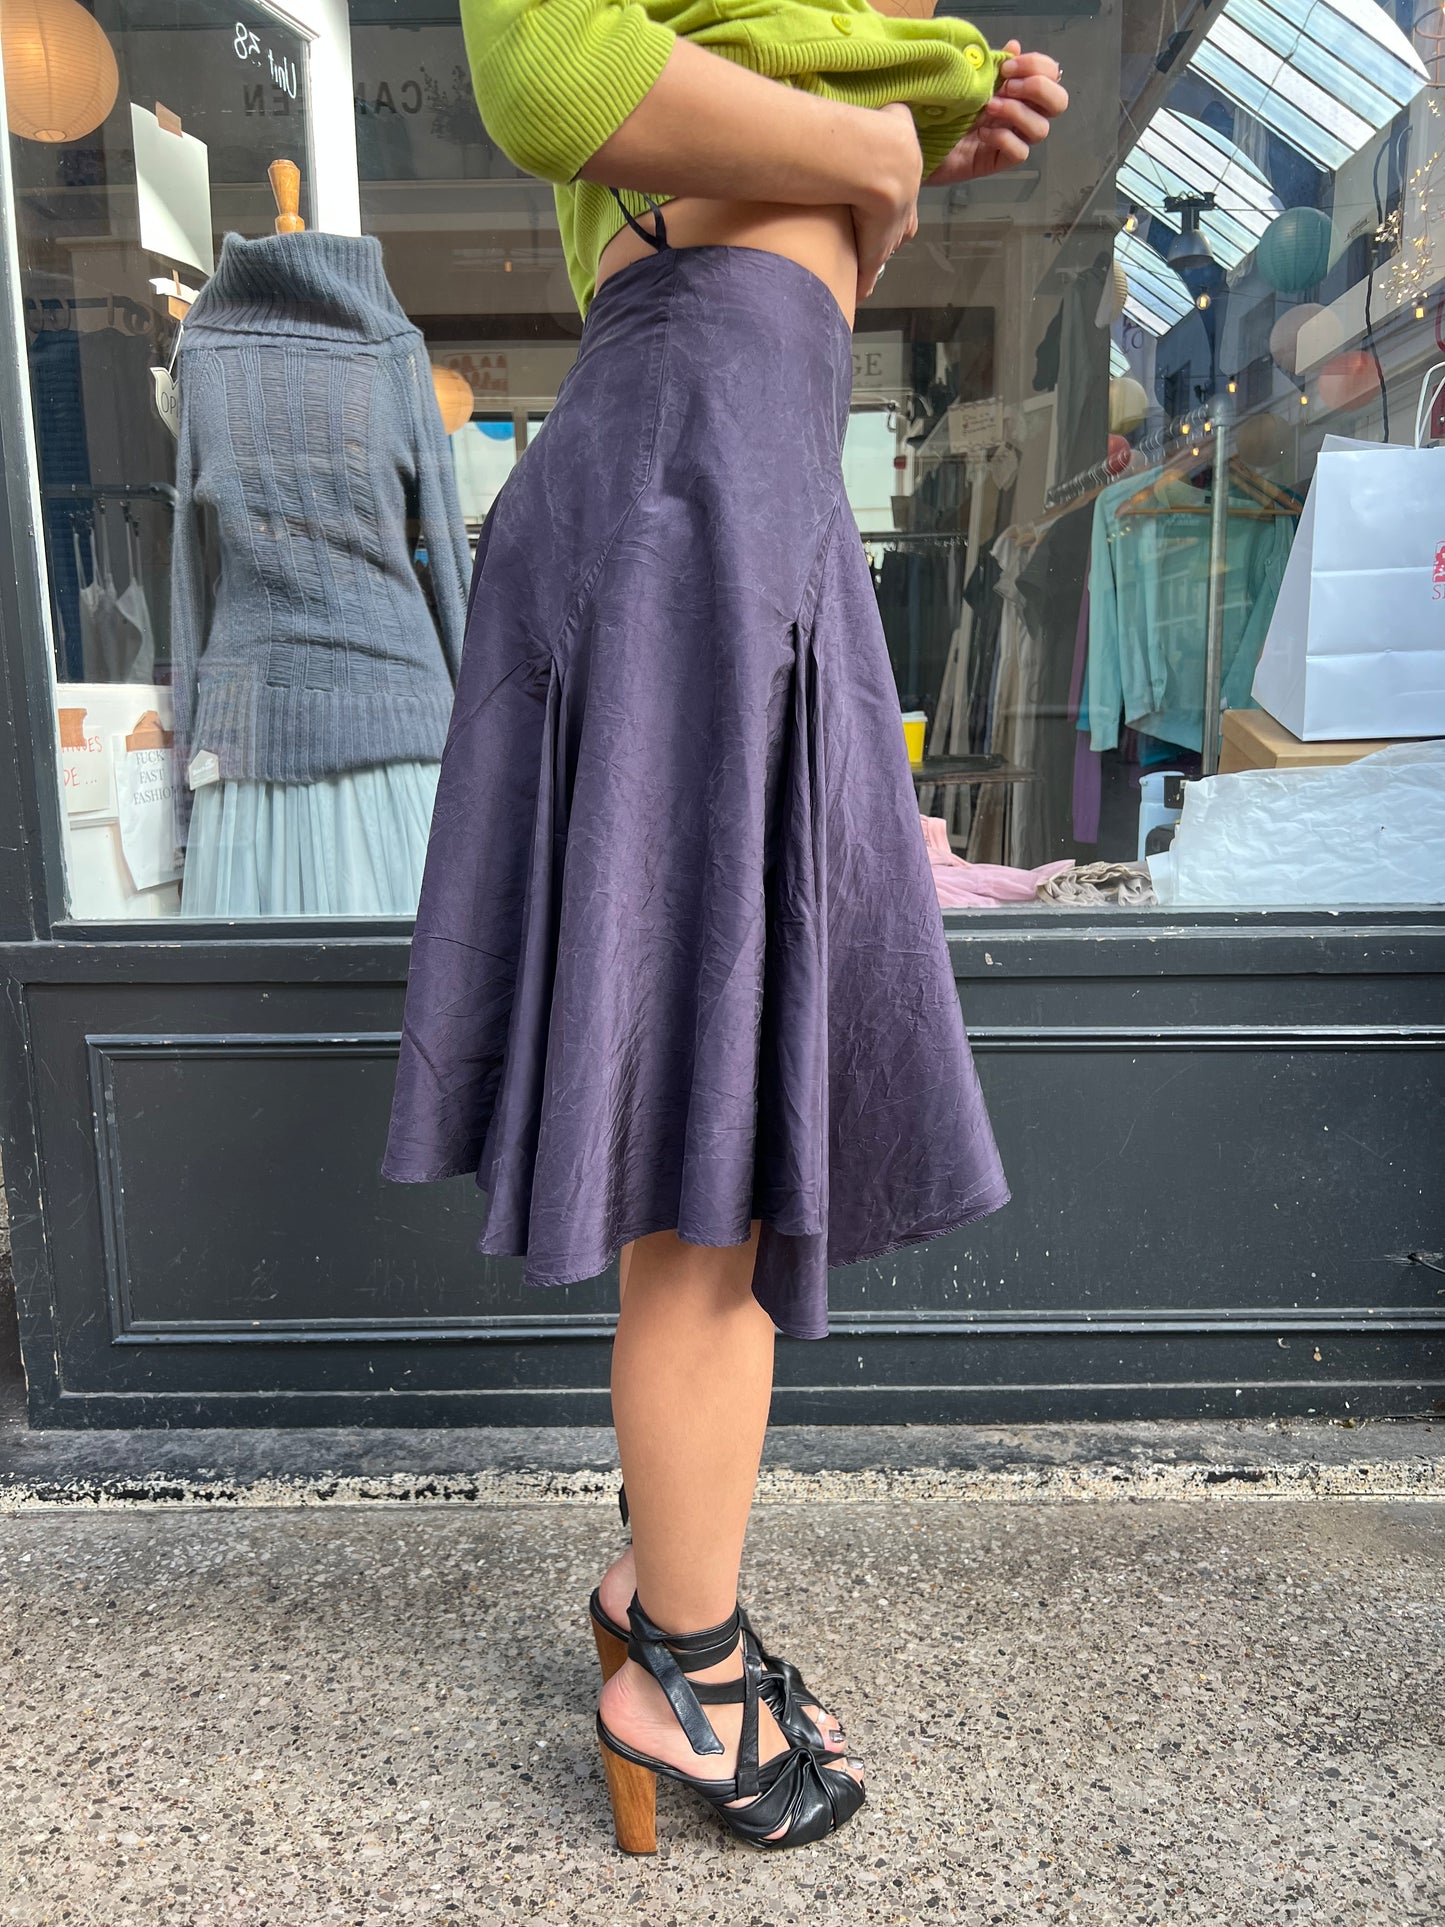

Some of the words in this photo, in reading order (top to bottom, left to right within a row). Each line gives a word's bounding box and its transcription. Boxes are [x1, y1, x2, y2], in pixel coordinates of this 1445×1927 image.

[135, 750, 165, 765] FUCK
[139, 768, 165, 784] FAST
[133, 785, 173, 805] FASHIO
